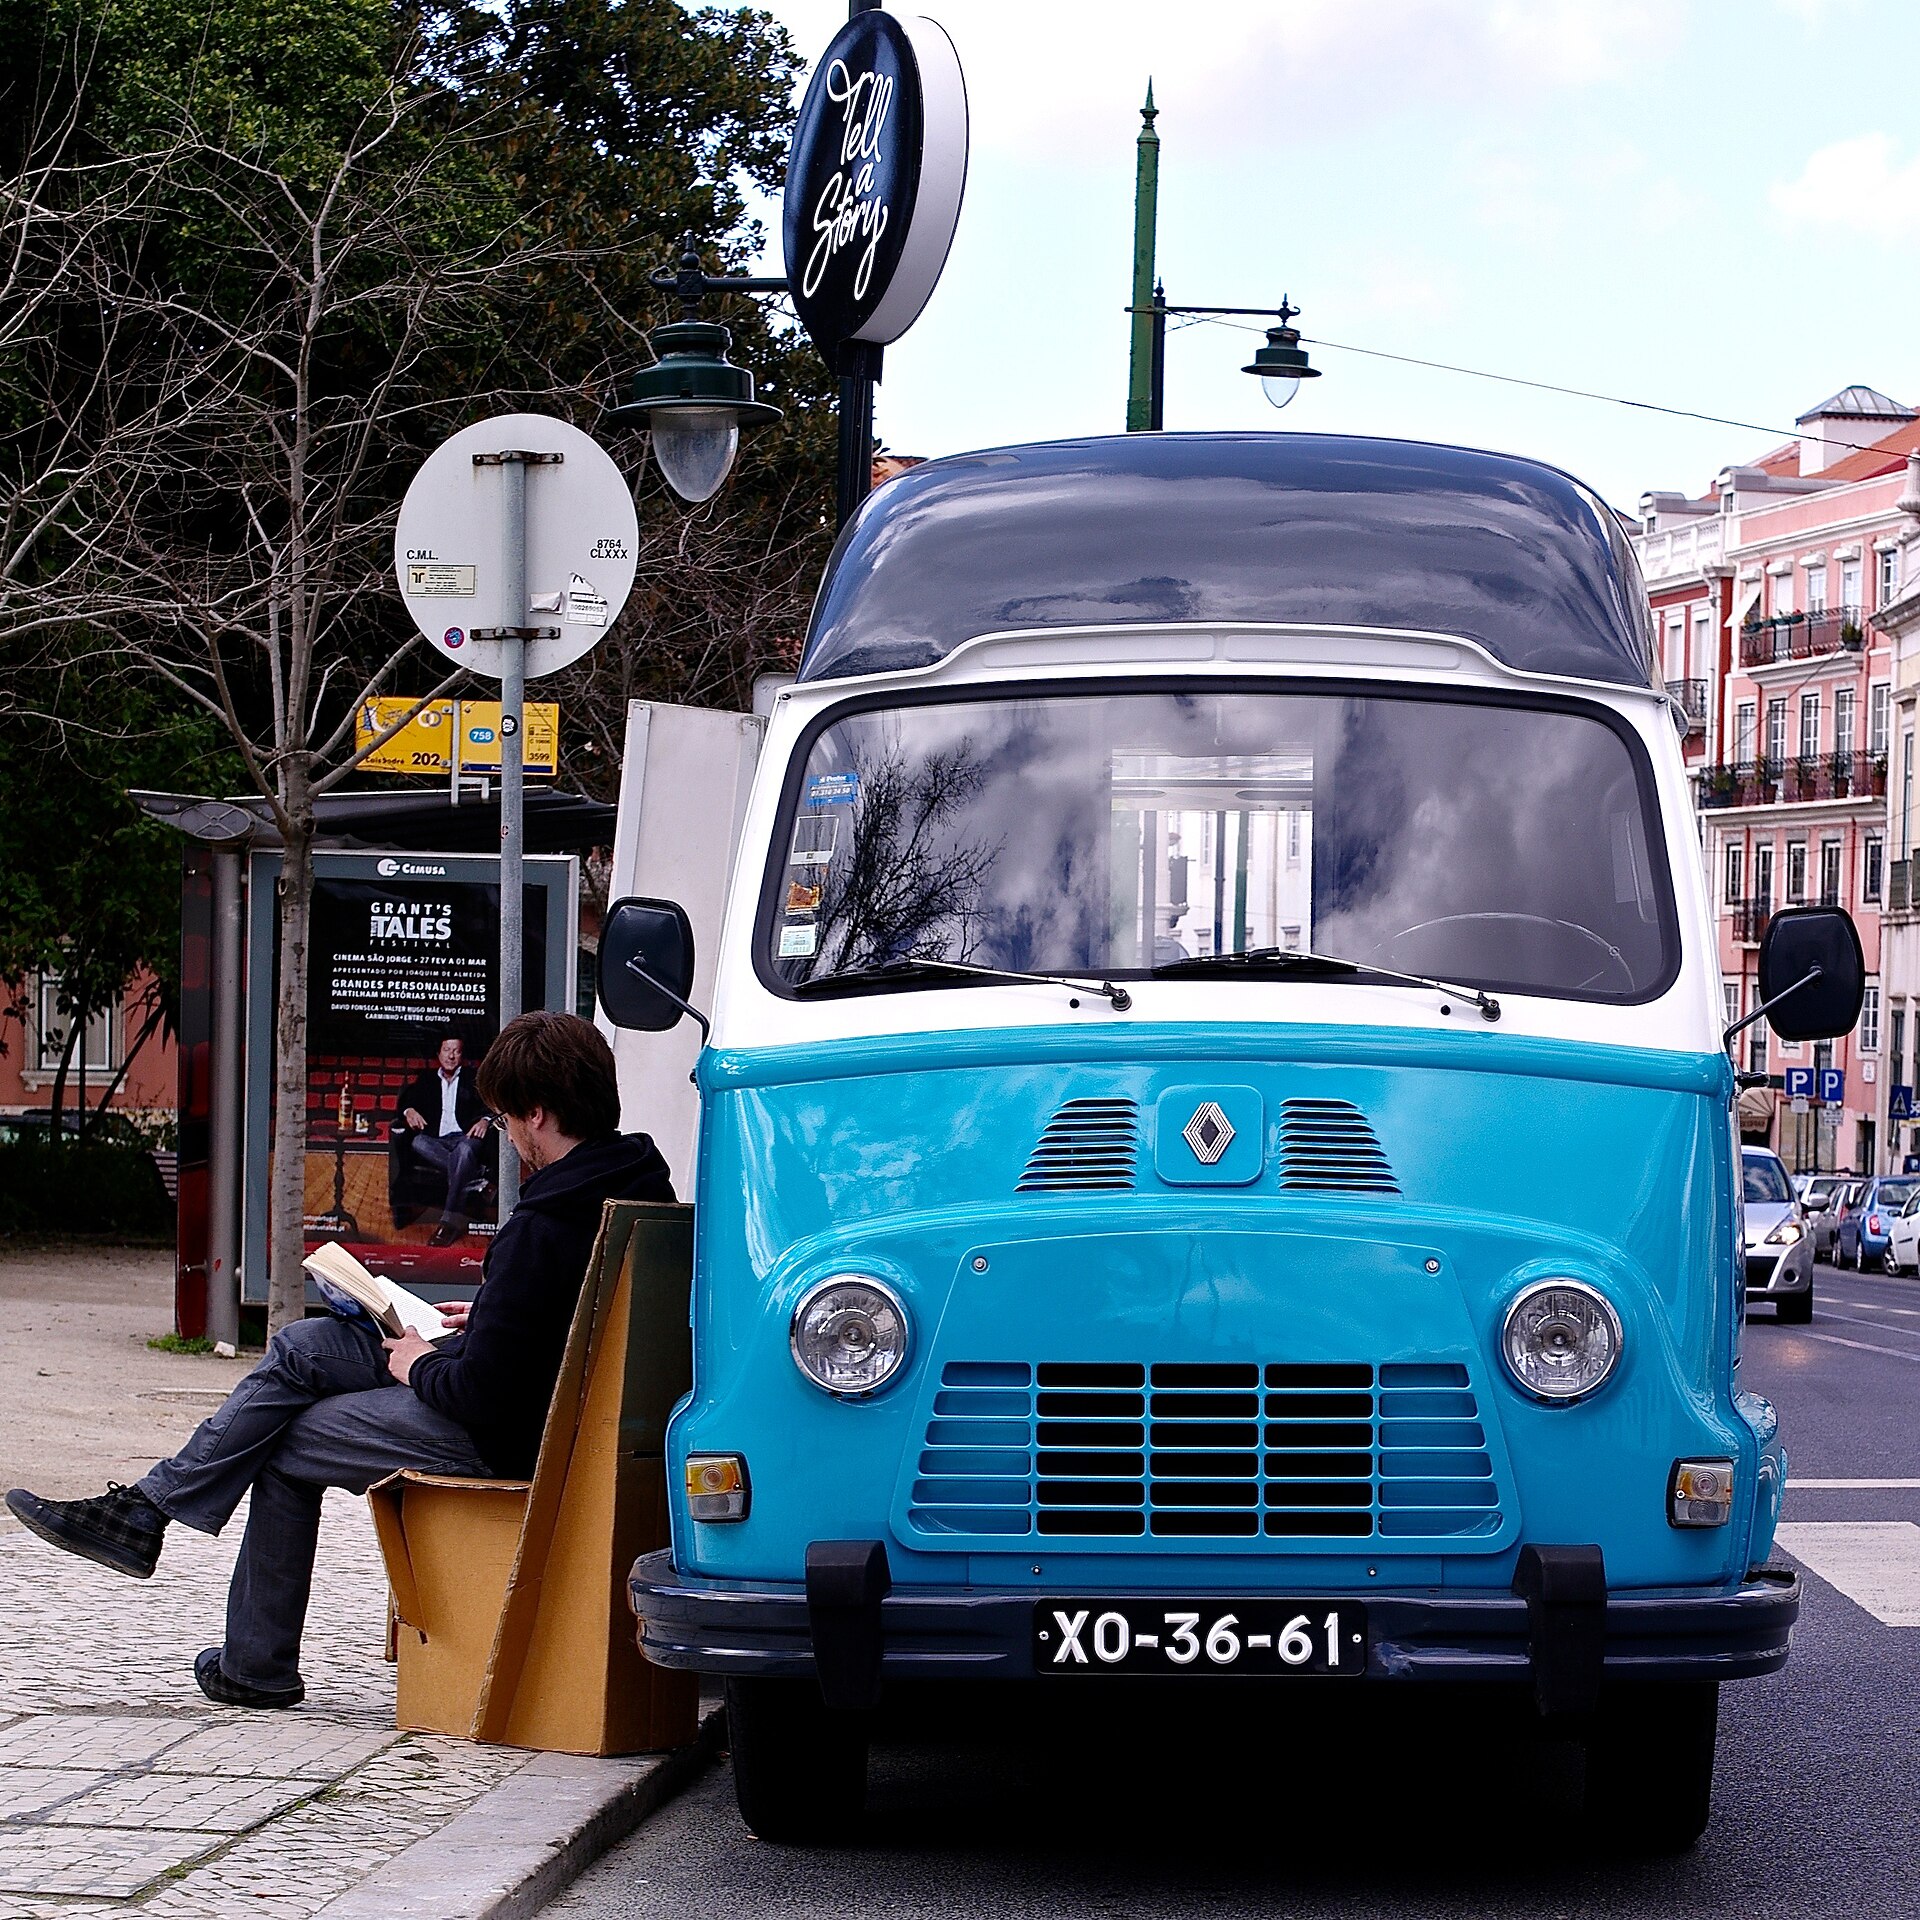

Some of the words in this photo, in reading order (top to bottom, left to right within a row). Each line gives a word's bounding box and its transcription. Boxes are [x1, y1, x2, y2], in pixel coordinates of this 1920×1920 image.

[826, 58, 894, 166] Tell
[856, 162, 875, 197] a
[803, 172, 889, 301] Story
[597, 539, 622, 549] 8764
[406, 550, 439, 560] C.M.L.
[590, 548, 628, 559] CLXXX
[472, 731, 492, 741] 758
[412, 752, 441, 766] 202
[529, 752, 550, 760] 3599
[370, 902, 452, 916] GRANT'S
[370, 915, 452, 940] TALES
[369, 939, 450, 949] FESTIVAL
[333, 954, 365, 962] CINEMA
[367, 953, 385, 963] SÃO
[386, 956, 412, 964] JORGE
[420, 956, 430, 964] 27
[431, 957, 447, 965] FEV
[468, 958, 487, 966] MAR
[332, 967, 386, 975] APRESENTADO
[331, 979, 384, 989] GRANDES
[387, 981, 486, 993] PERSONALIDADES
[331, 989, 379, 998] PARTILHAM
[380, 990, 426, 1000] HISTÓRIAS
[428, 992, 486, 1002] VERDADEIRAS
[1791, 1071, 1809, 1093] P
[1825, 1072, 1839, 1098] P
[468, 1223, 495, 1231] BILHETES
[1052, 1611, 1339, 1666] XO-36-61
